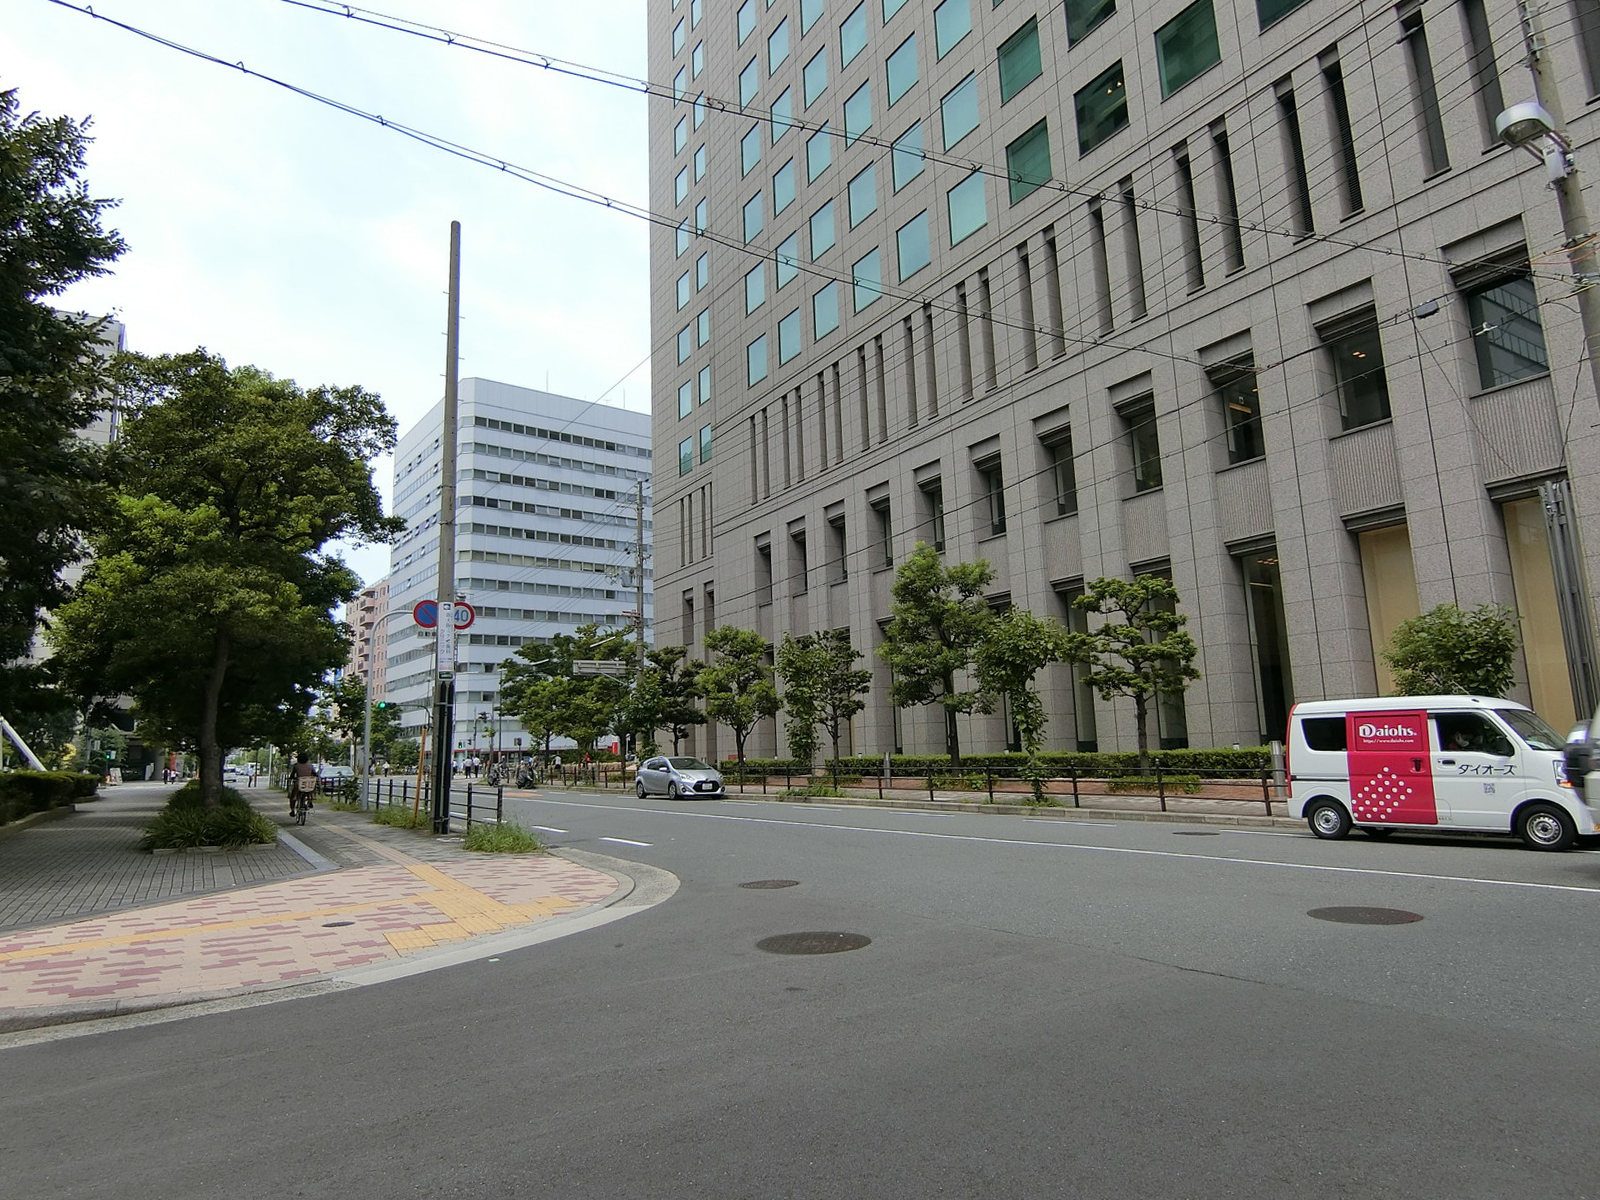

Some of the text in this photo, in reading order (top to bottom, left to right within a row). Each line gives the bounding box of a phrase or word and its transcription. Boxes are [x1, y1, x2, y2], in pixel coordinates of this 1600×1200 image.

[454, 609, 469, 622] 40
[1358, 723, 1414, 738] Daiohs
[1457, 764, 1518, 776] ダイオーズ
